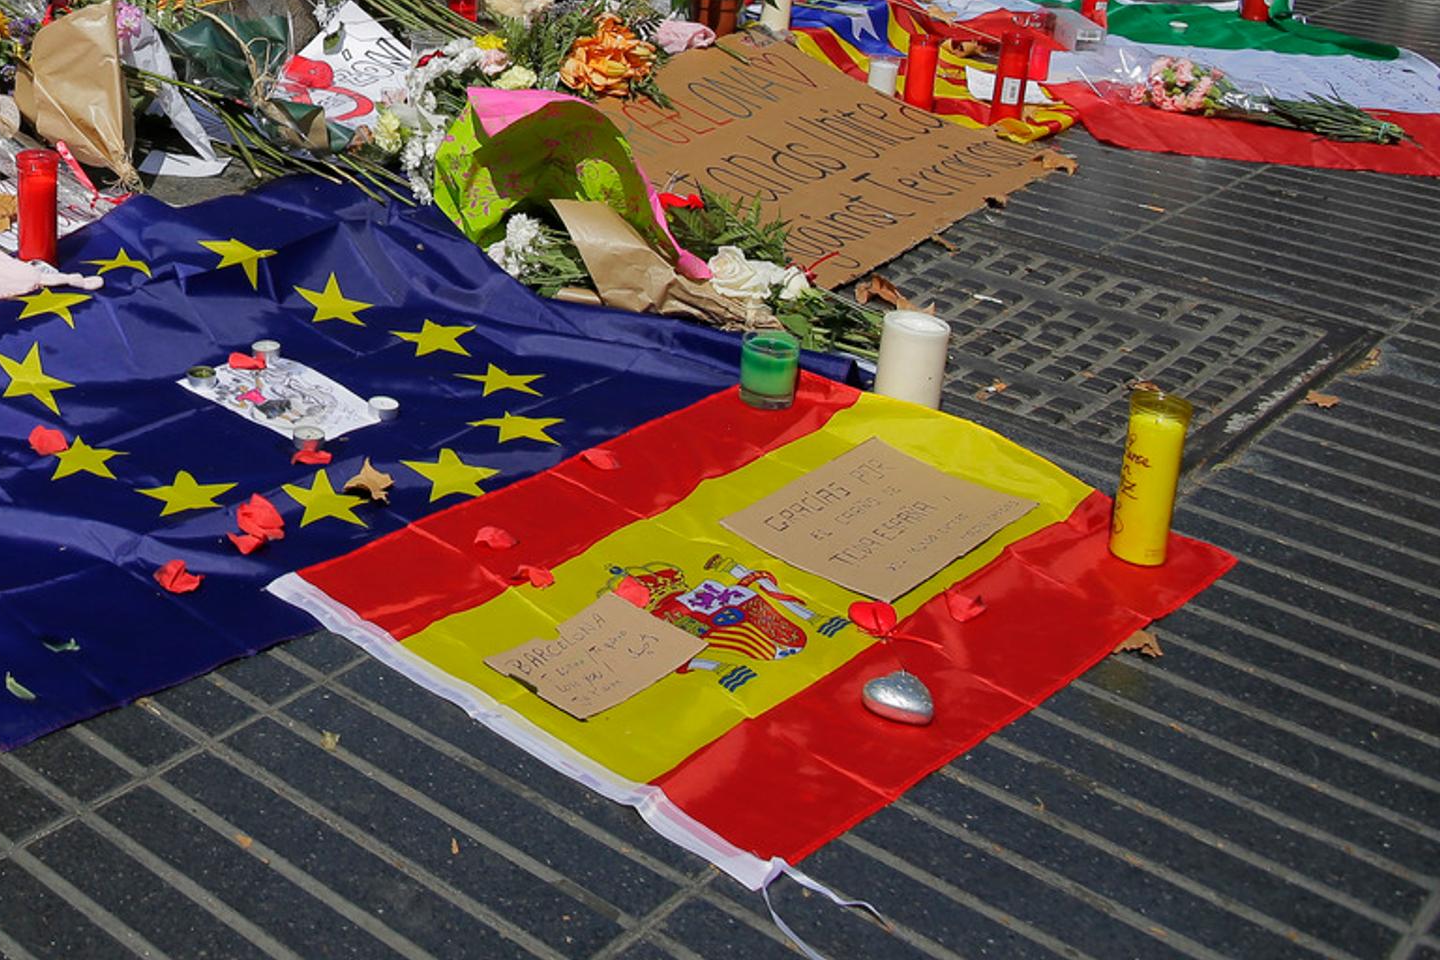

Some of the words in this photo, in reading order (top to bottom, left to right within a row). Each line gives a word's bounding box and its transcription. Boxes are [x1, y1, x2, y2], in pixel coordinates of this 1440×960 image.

[654, 135, 847, 210] tands
[784, 192, 916, 270] gainst
[510, 612, 606, 676] BARCELONA
